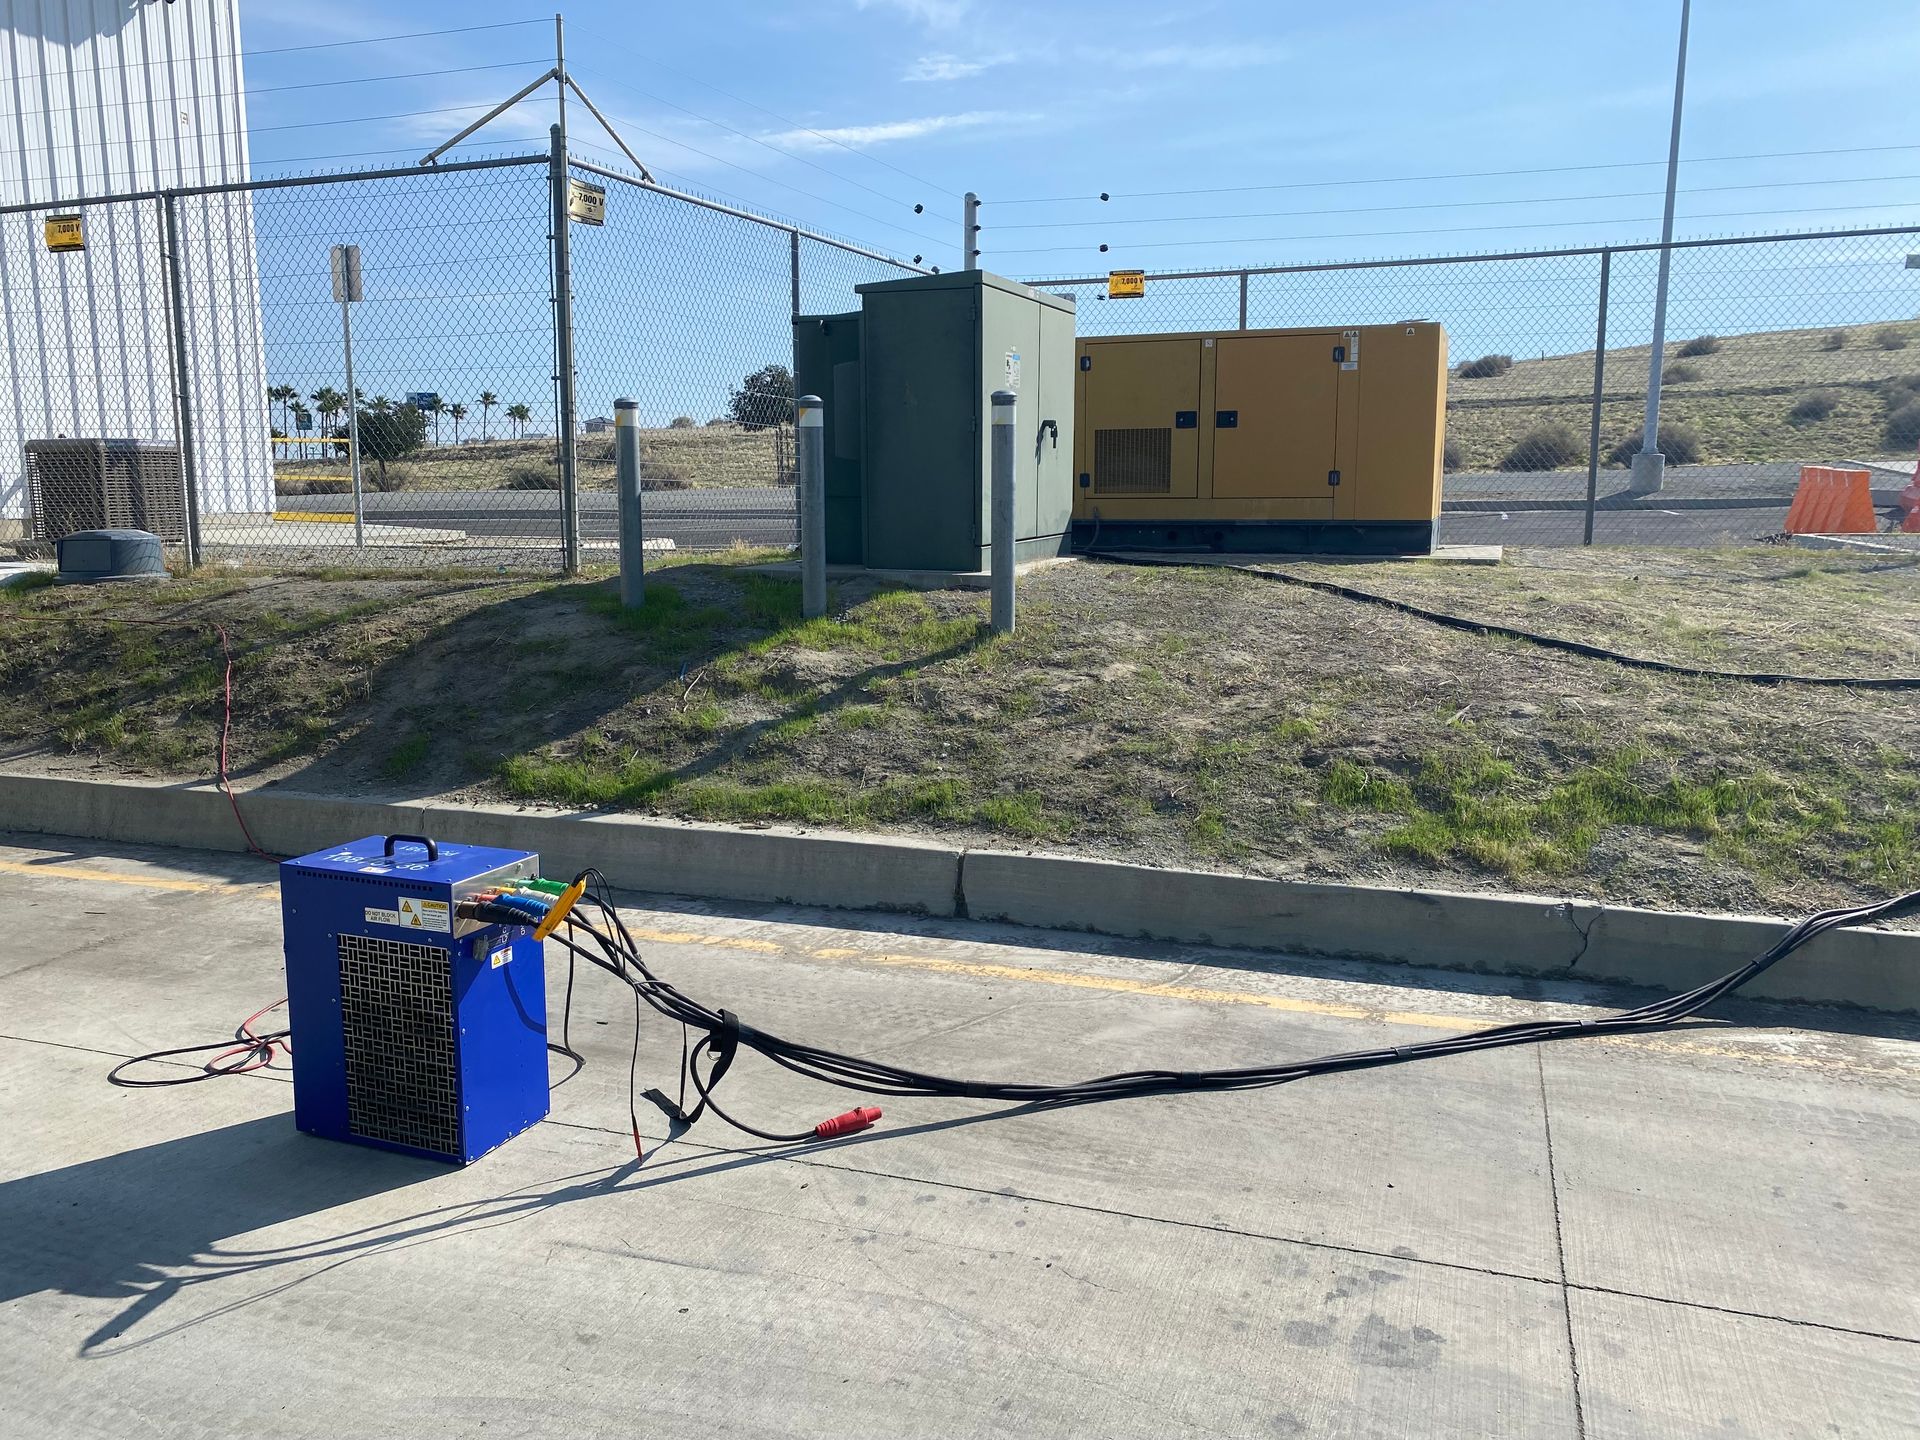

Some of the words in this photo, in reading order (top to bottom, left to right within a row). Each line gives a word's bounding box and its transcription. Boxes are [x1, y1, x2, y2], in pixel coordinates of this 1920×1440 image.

[579, 192, 597, 205] 7,000
[598, 197, 604, 206] V
[57, 224, 74, 234] 7,000
[75, 223, 80, 232] V
[1121, 277, 1138, 285] 7,000
